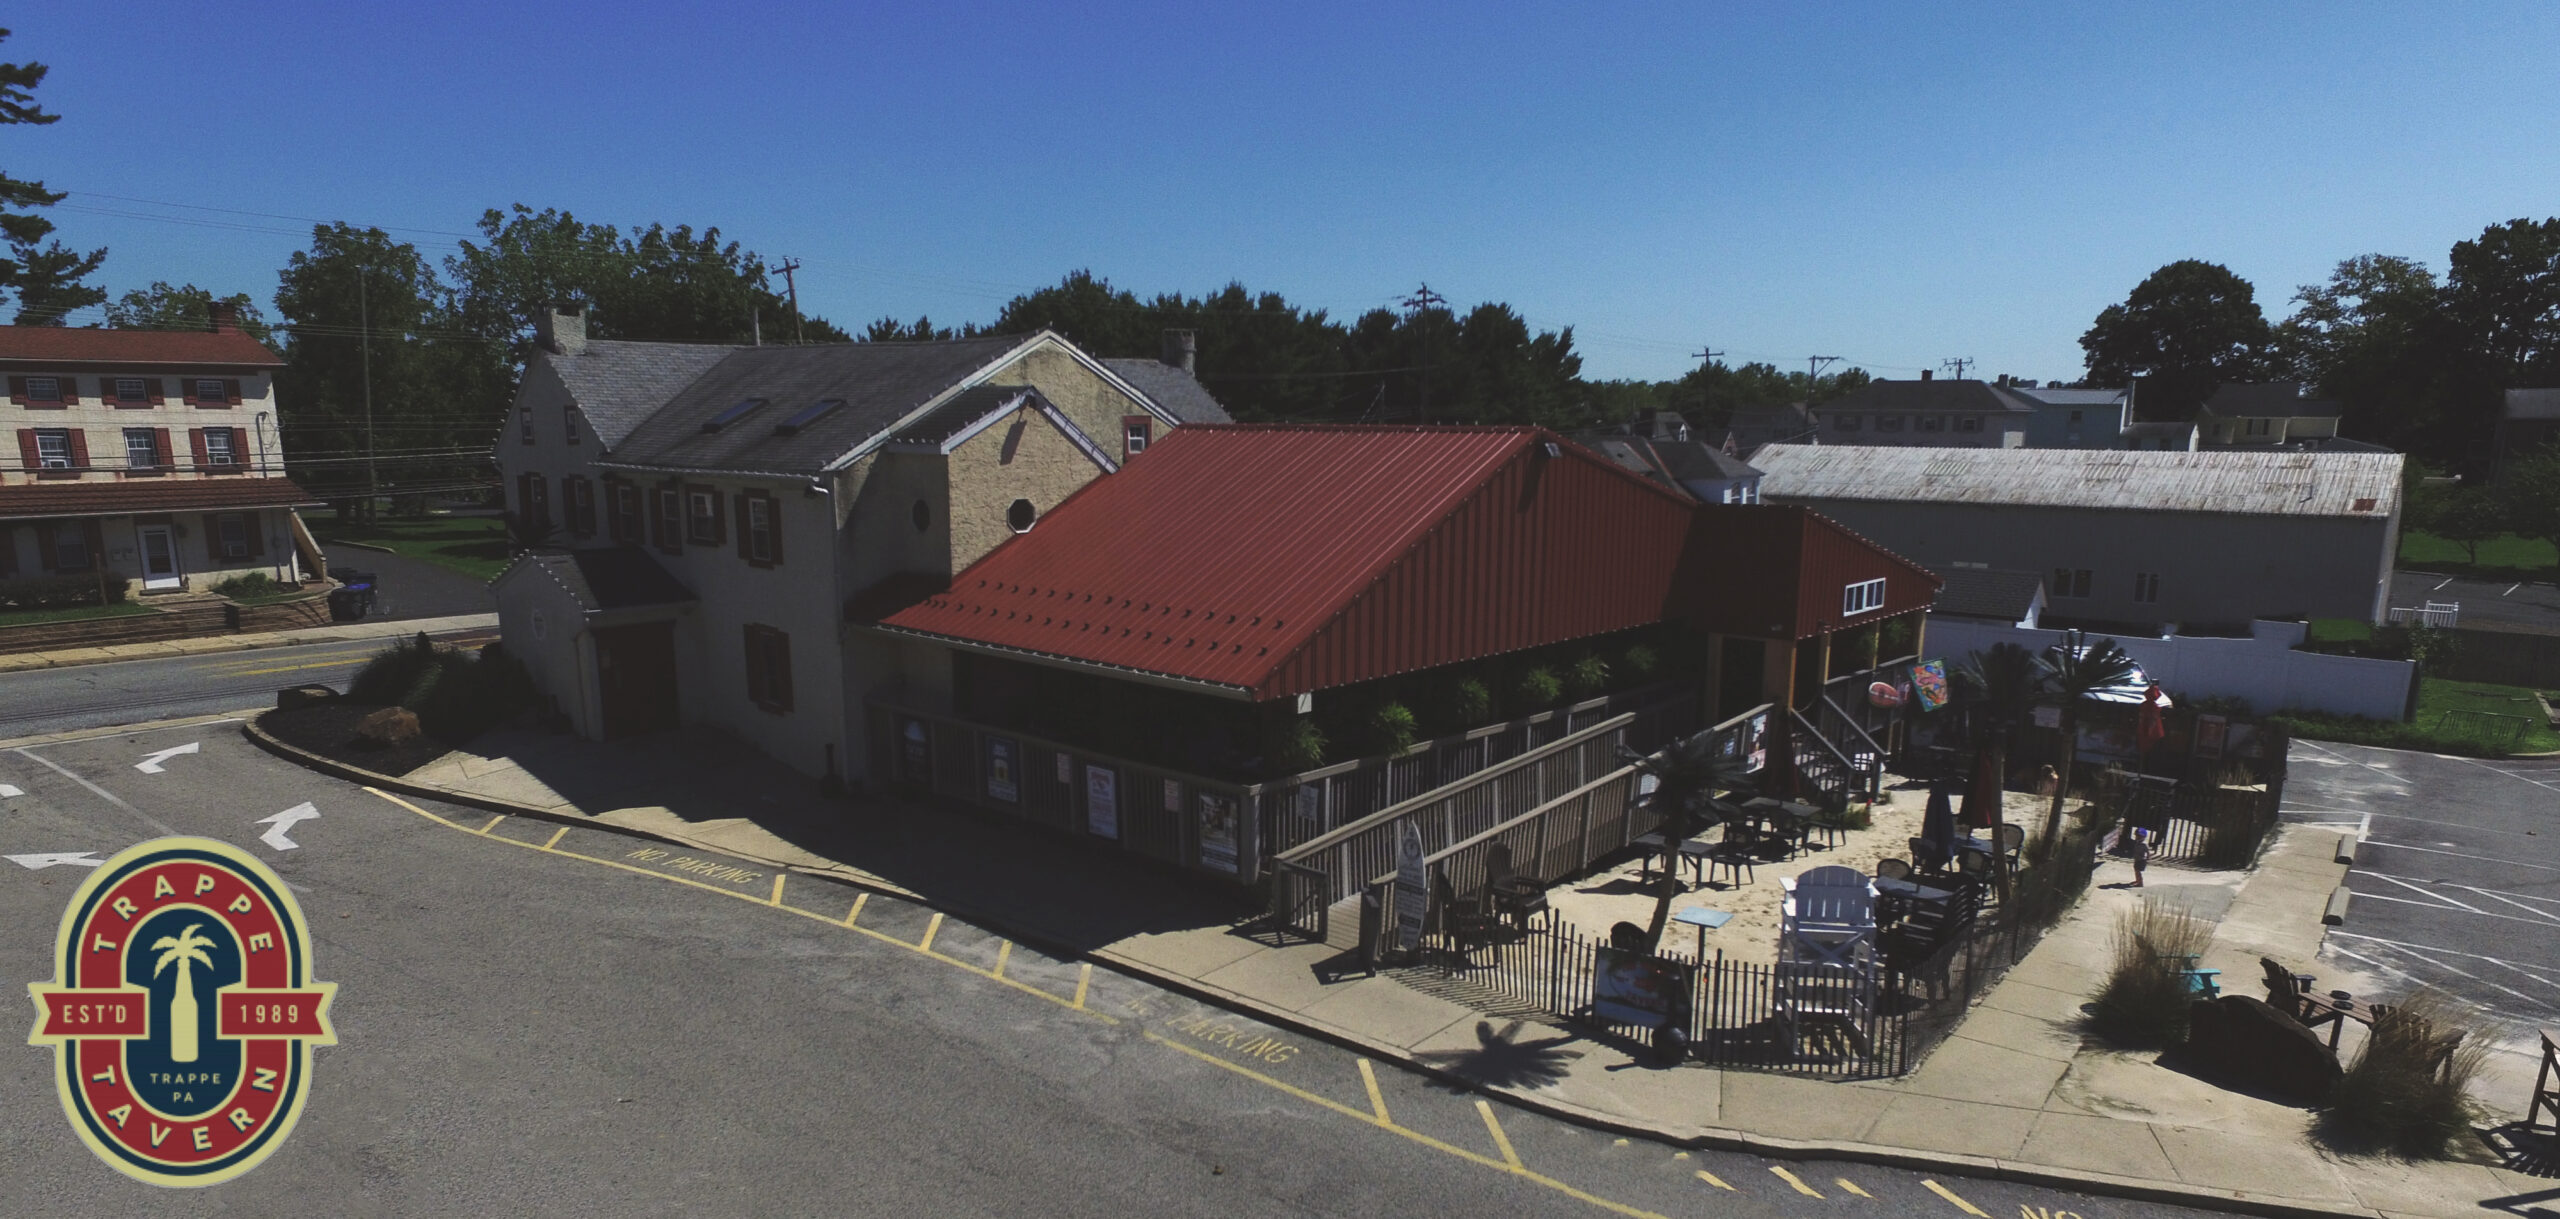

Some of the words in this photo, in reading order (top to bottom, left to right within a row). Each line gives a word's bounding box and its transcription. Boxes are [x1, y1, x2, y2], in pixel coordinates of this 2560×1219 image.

[625, 848, 669, 861] NO
[661, 856, 762, 884] PARKING
[1166, 1012, 1299, 1063] PARKING
